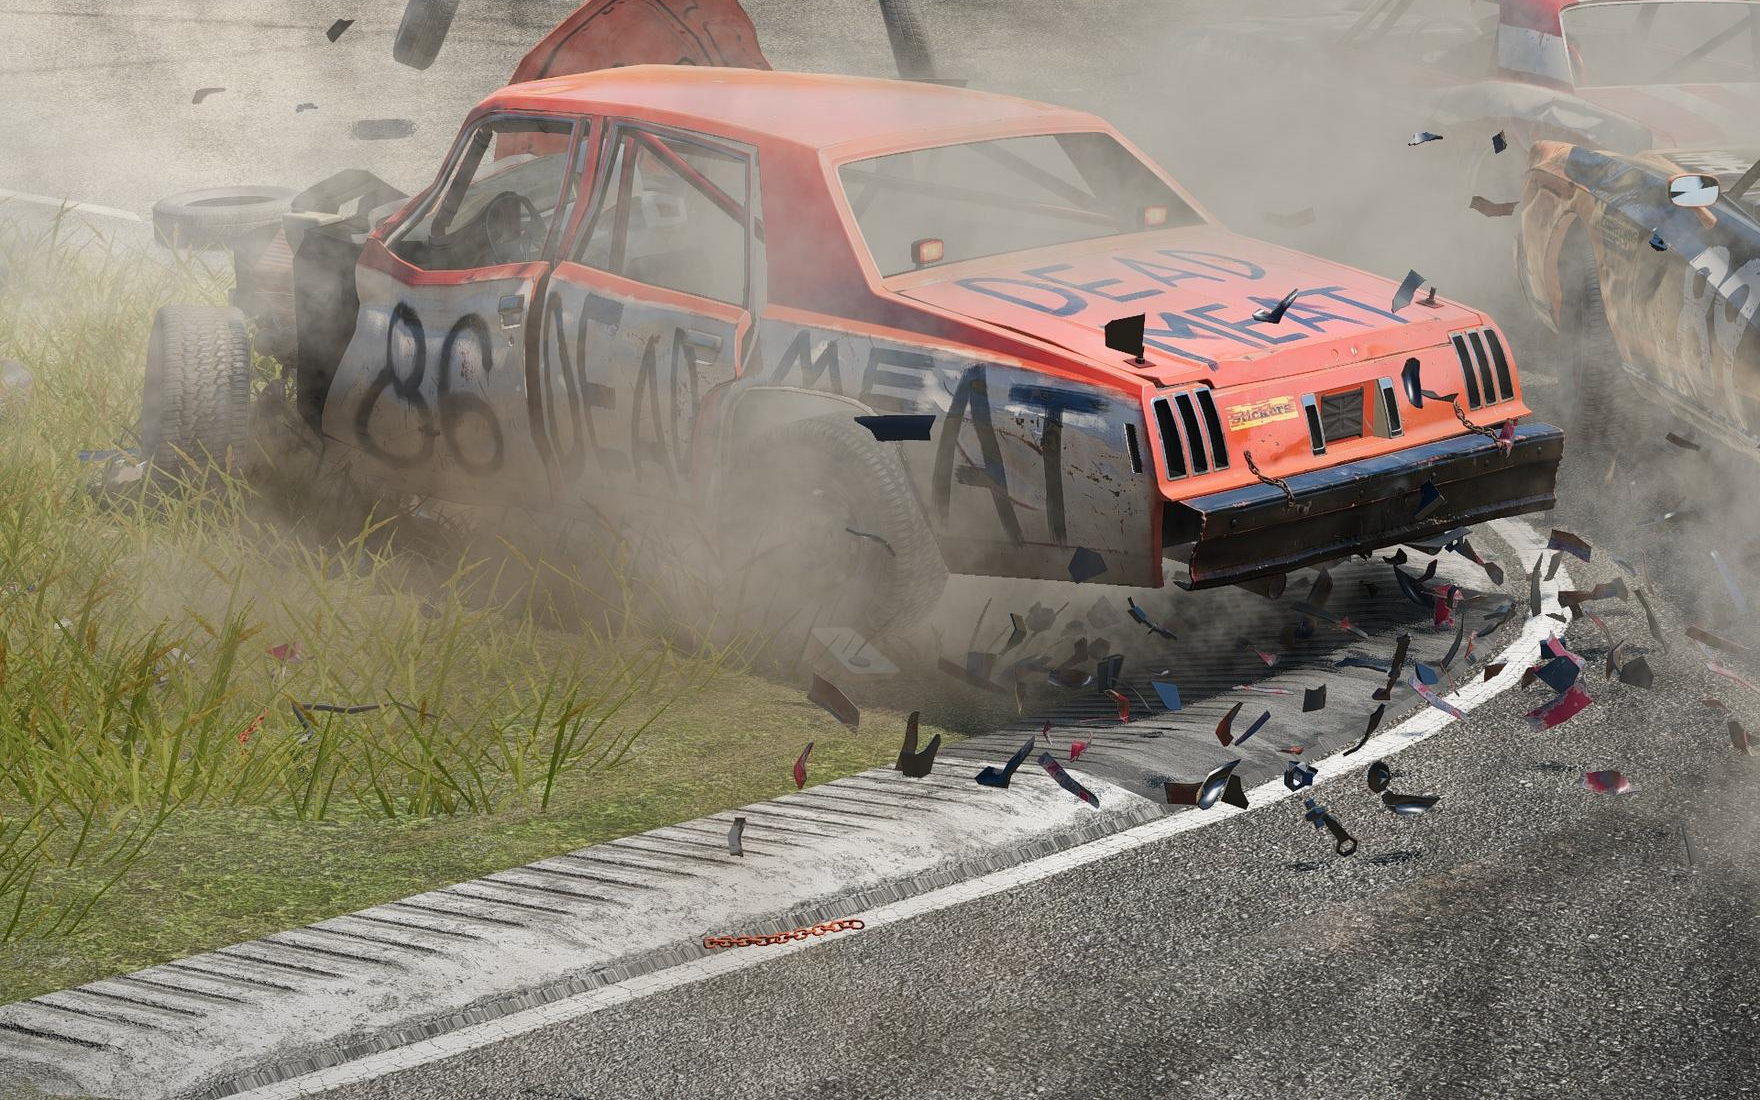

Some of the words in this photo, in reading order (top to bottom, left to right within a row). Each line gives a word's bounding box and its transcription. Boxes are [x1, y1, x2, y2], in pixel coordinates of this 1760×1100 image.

[954, 249, 1266, 317] DEAD
[1101, 286, 1409, 372] MEAT
[356, 301, 504, 477] 86
[542, 290, 702, 493] DEAD
[770, 329, 1112, 549] MEAT
